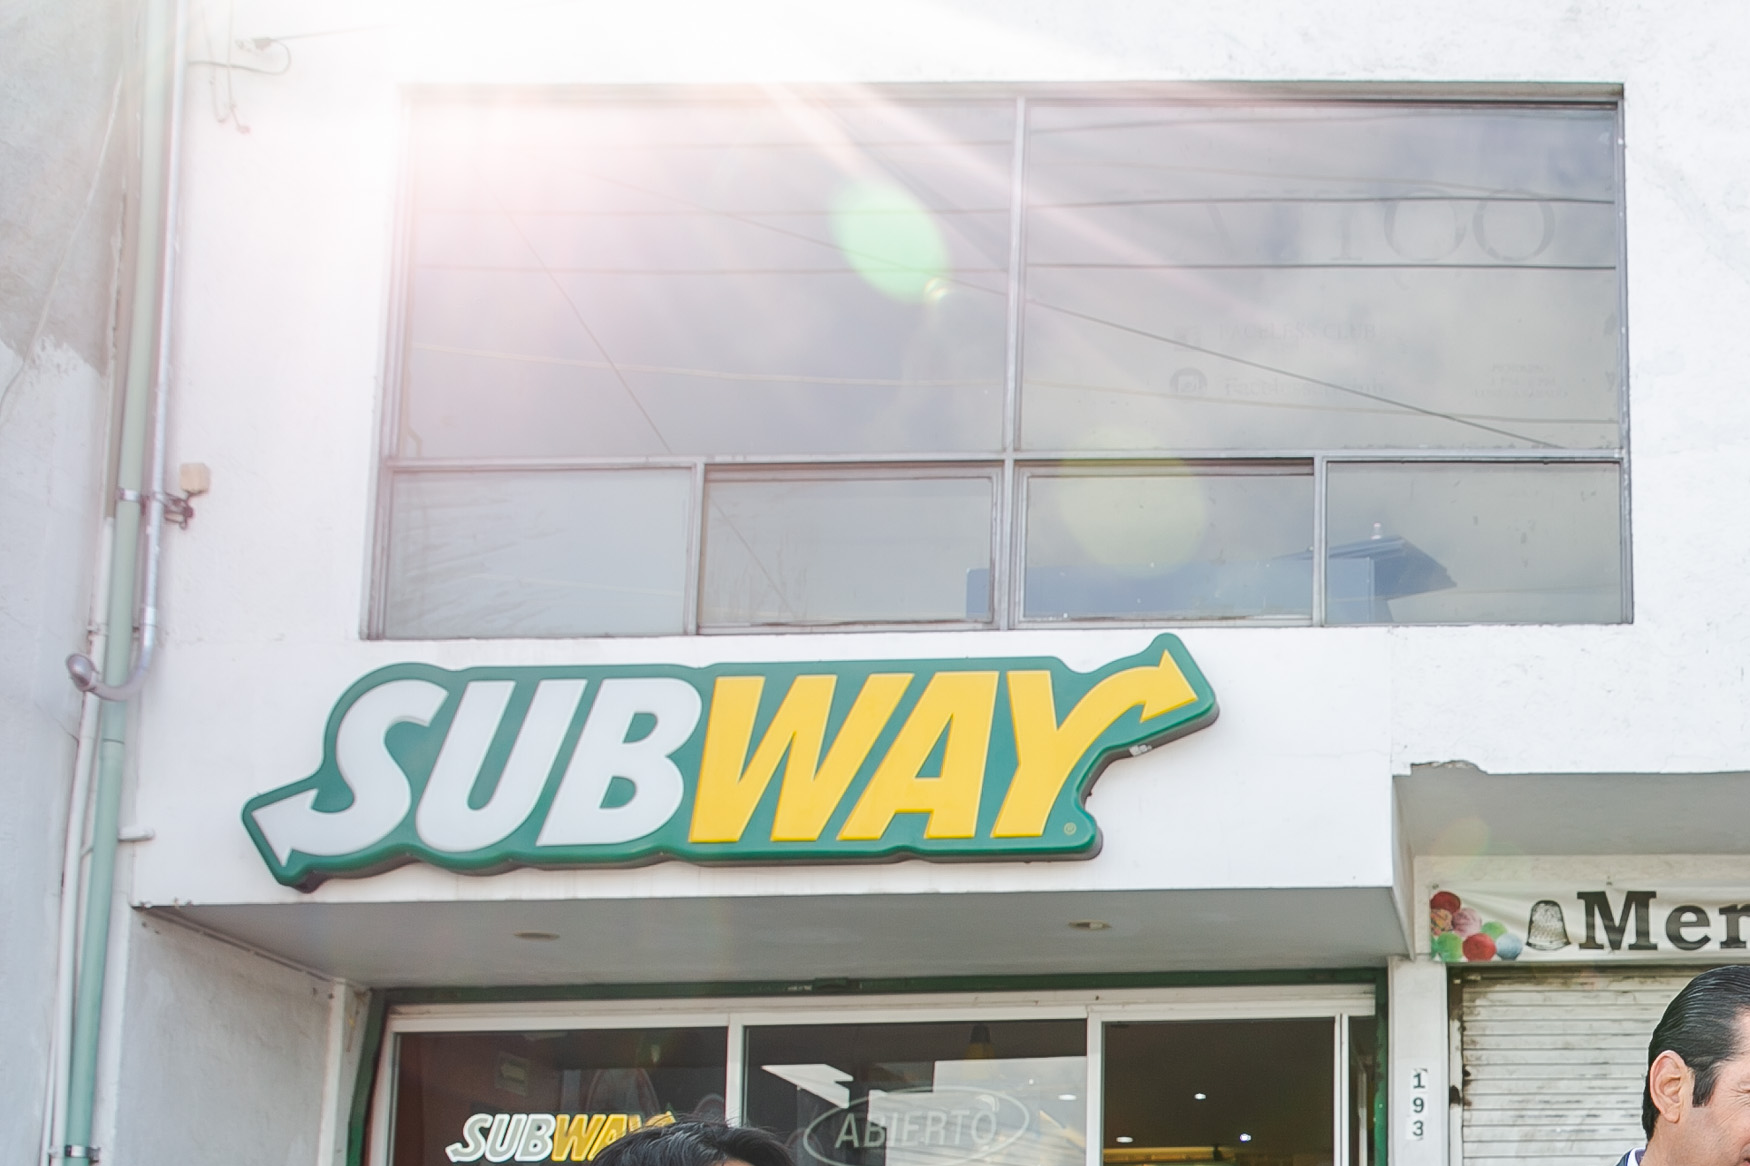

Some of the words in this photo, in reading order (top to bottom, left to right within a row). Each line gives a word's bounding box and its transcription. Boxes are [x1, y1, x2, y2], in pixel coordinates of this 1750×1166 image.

[250, 650, 1202, 867] SUBWAY
[834, 1109, 999, 1149] ABIERTO
[1412, 1072, 1427, 1137] 193
